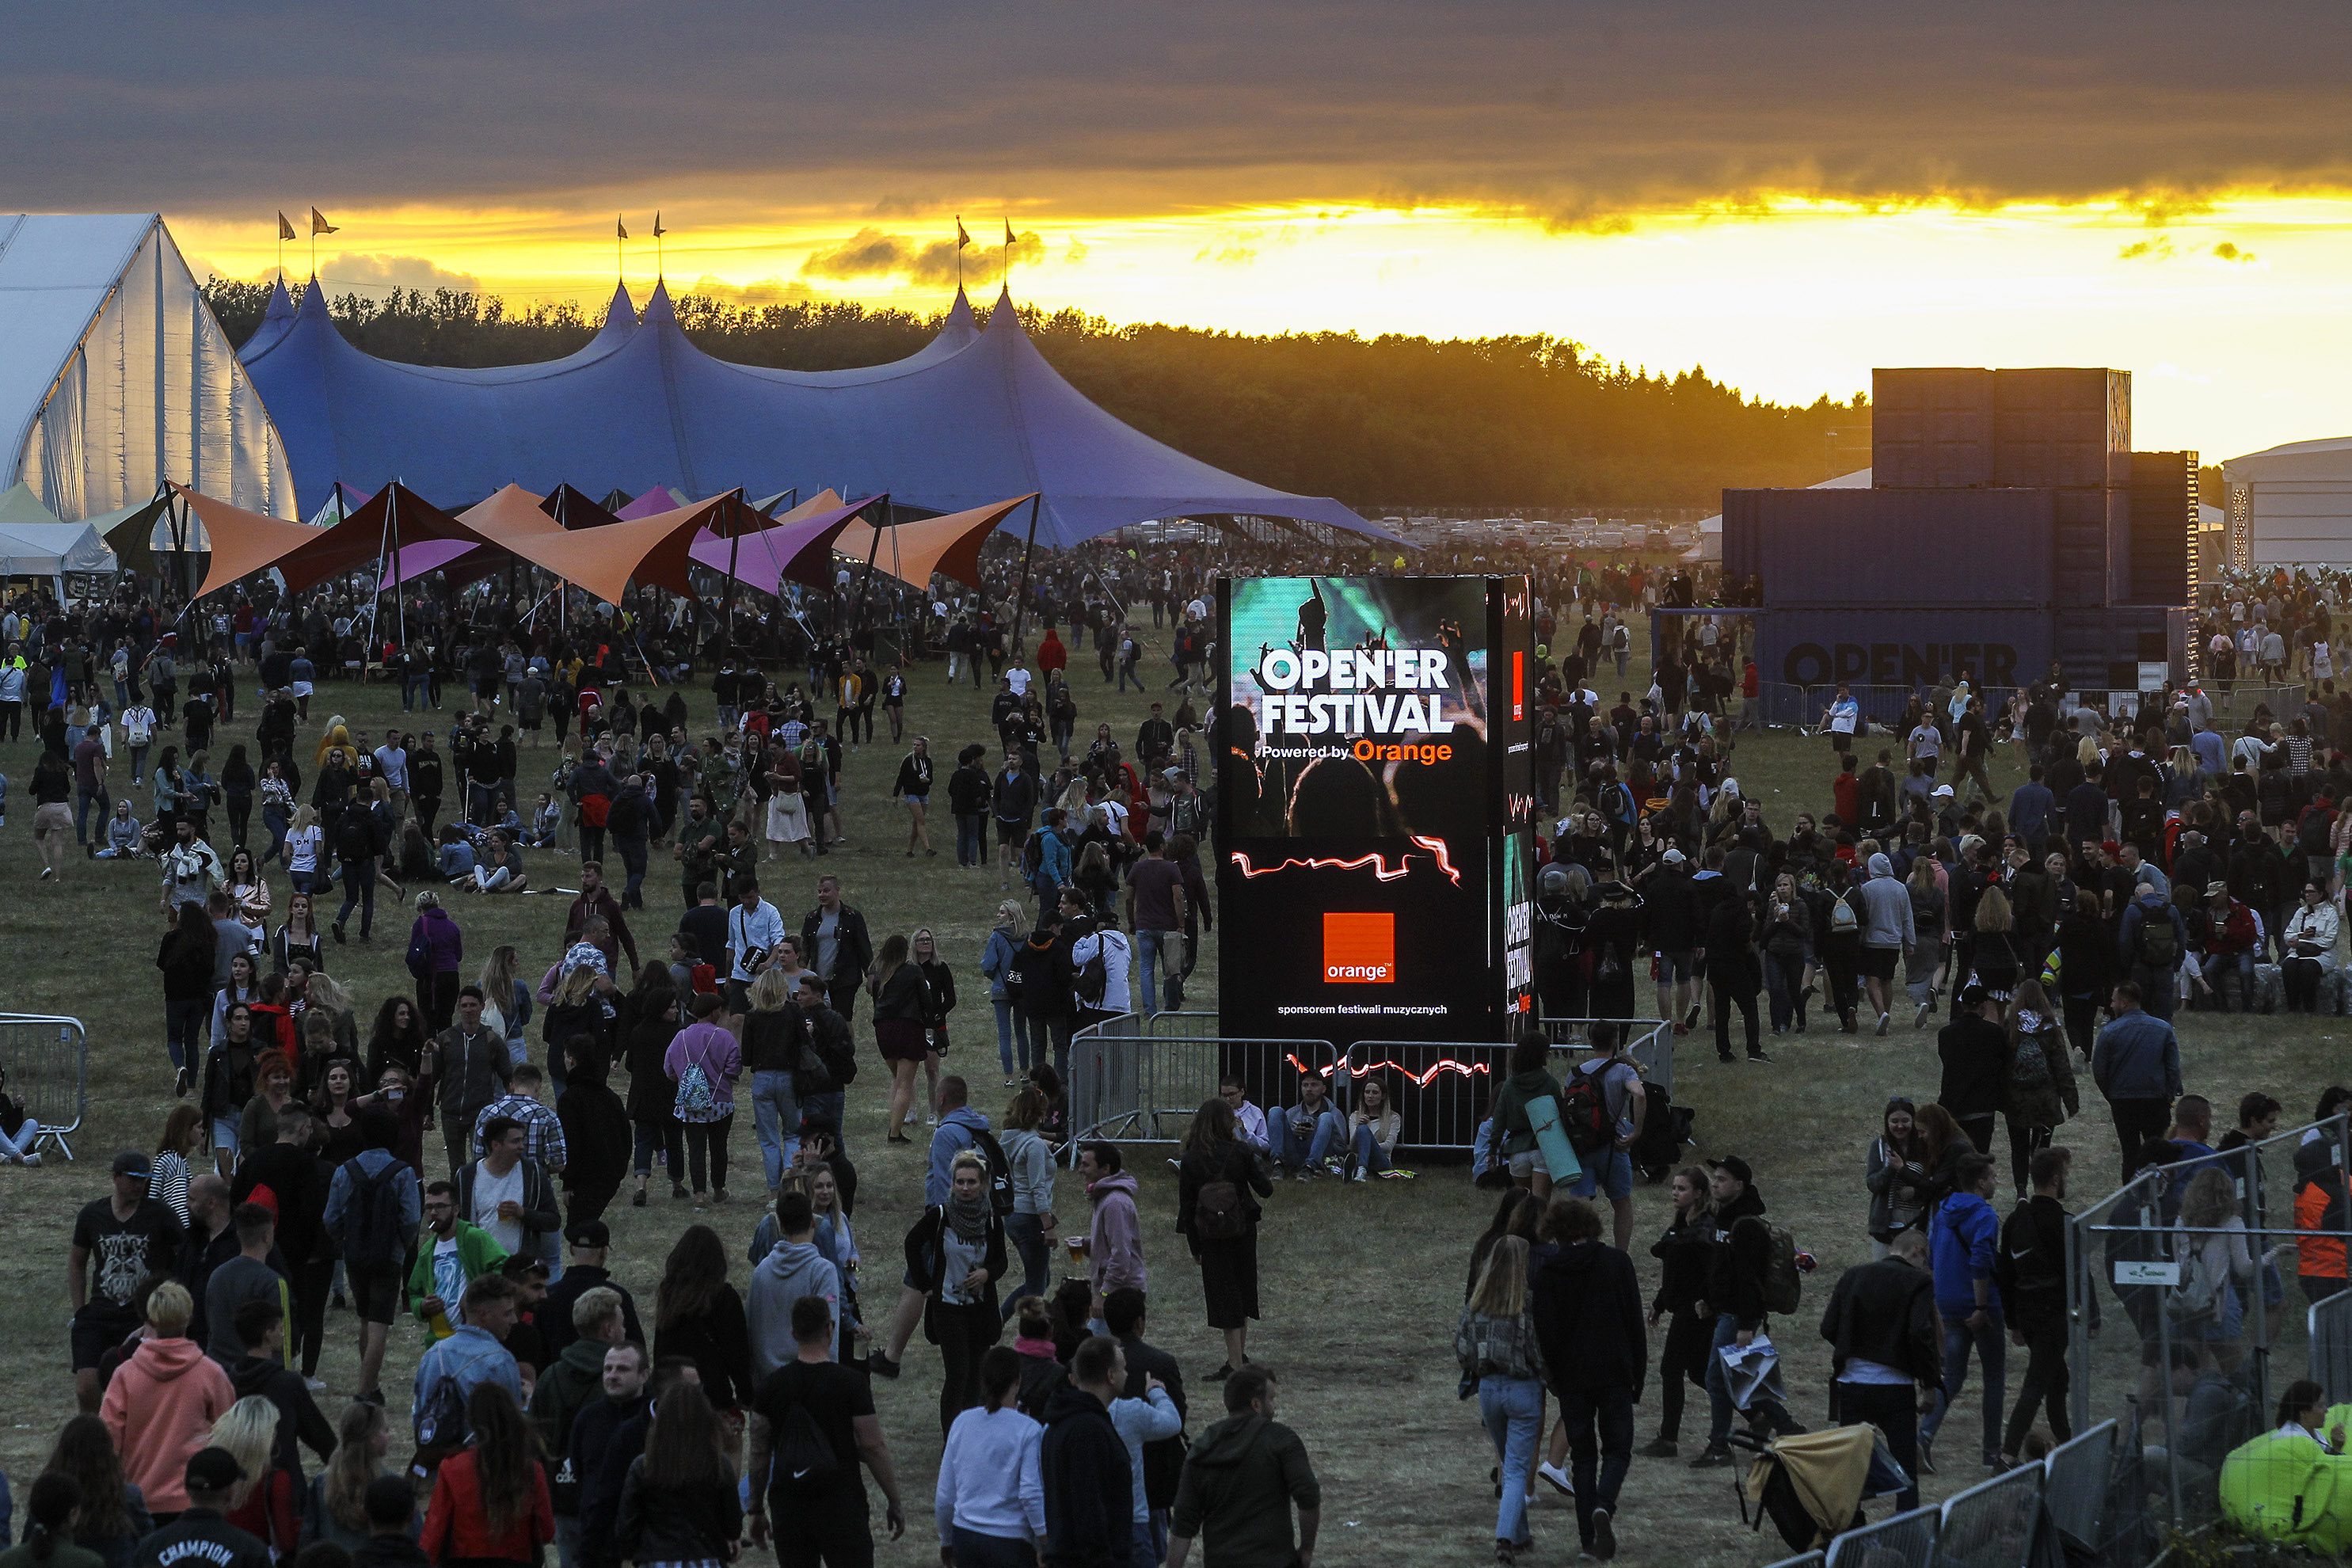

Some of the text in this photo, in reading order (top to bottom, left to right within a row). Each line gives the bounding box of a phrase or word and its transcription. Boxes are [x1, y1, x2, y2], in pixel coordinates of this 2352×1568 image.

[1262, 649, 1450, 690] OPEN'ER
[1783, 642, 2017, 695] OPEN'ER
[1262, 694, 1455, 734] FESTIVAL
[1262, 740, 1452, 766] Powered by Orange
[1327, 966, 1387, 981] orange
[1278, 1004, 1448, 1015] sponsorem festiwali muzycznych
[158, 1539, 234, 1567] CHAMPION
